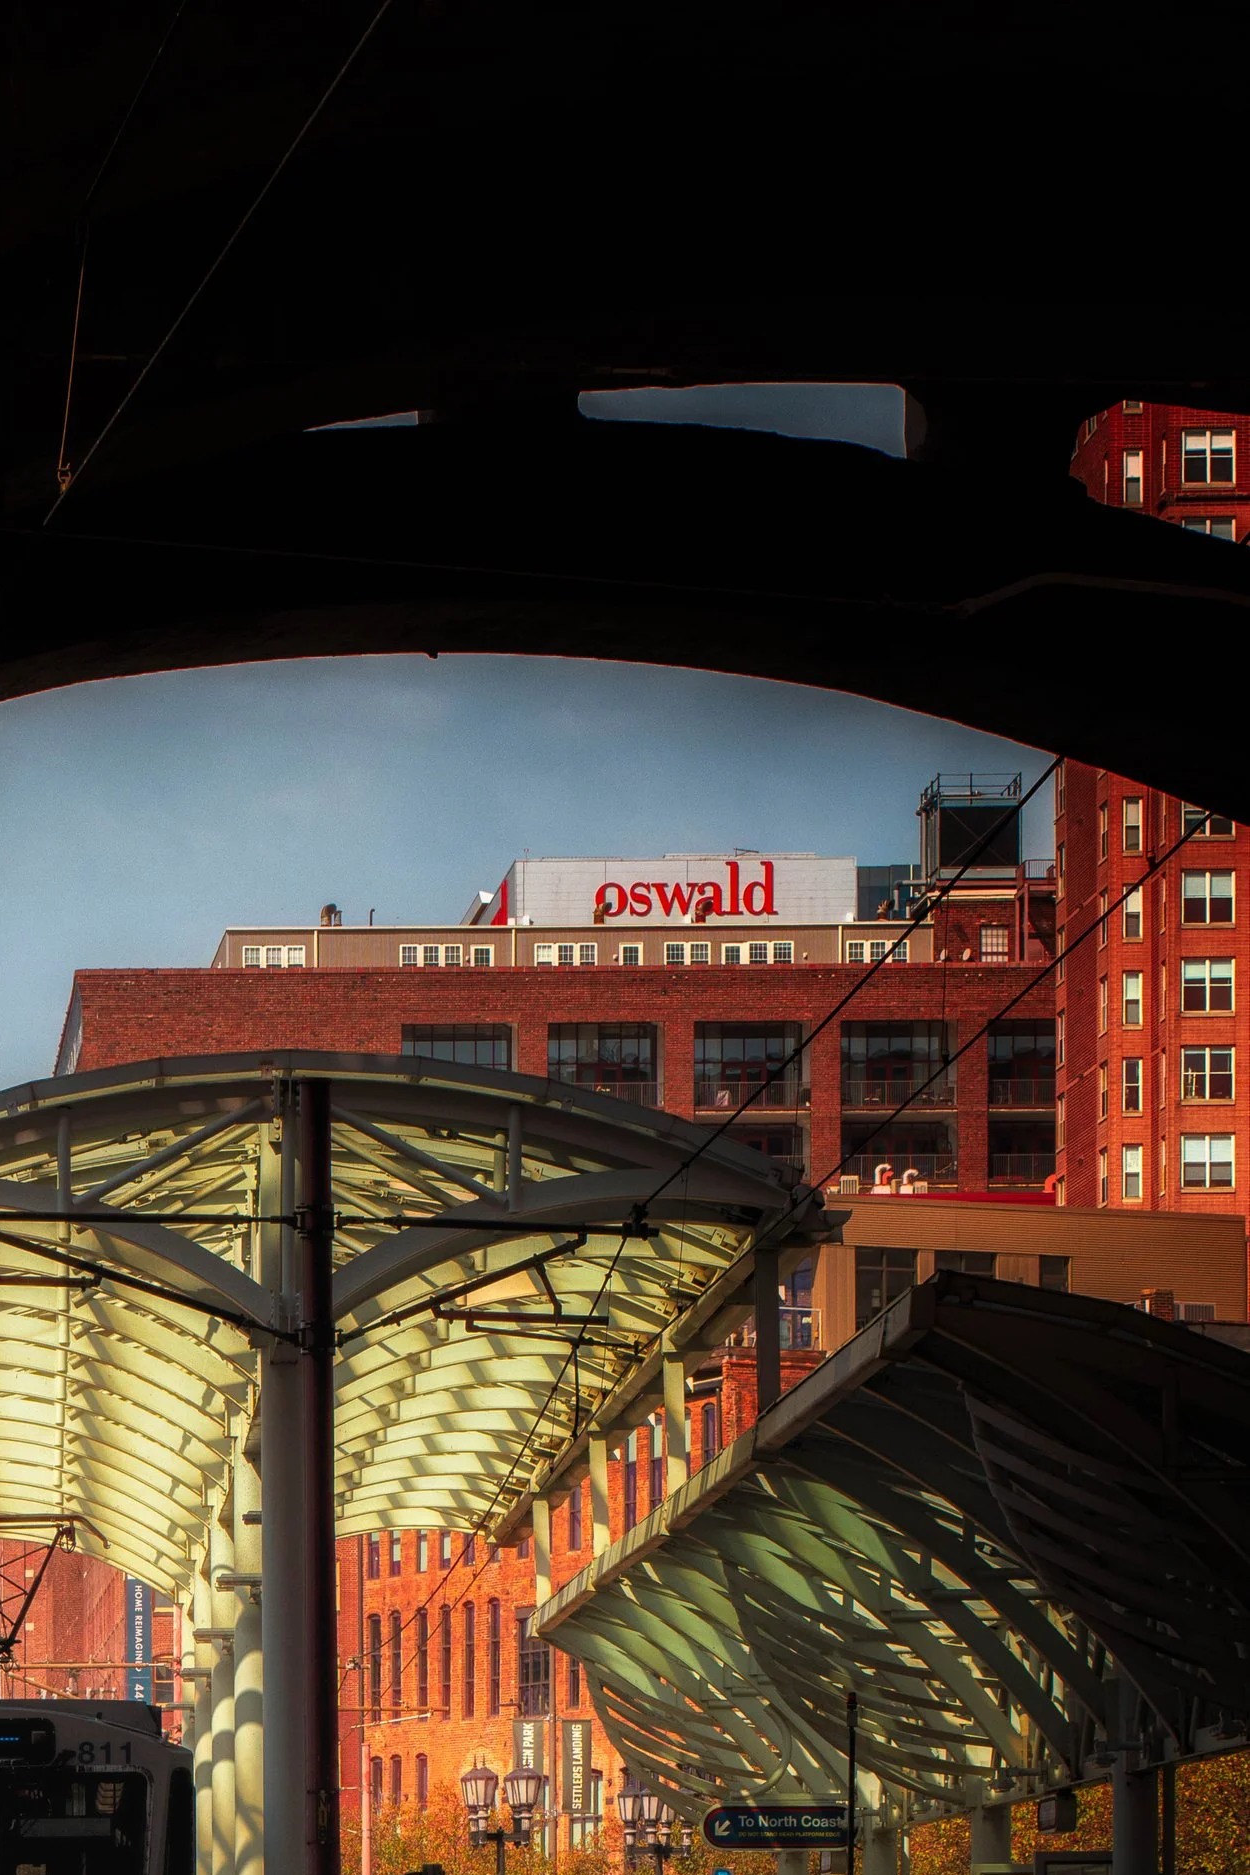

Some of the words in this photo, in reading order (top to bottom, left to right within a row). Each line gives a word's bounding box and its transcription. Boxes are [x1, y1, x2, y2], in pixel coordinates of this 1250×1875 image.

[595, 861, 778, 917] oswald
[134, 1585, 143, 1612] HOME
[522, 1722, 534, 1748] PARK
[571, 1724, 583, 1765] LANDING
[78, 1741, 132, 1765] 811
[571, 1766, 583, 1809] SETTLERS
[737, 1815, 754, 1828] To
[758, 1815, 797, 1828] North
[801, 1815, 841, 1828] Coast
